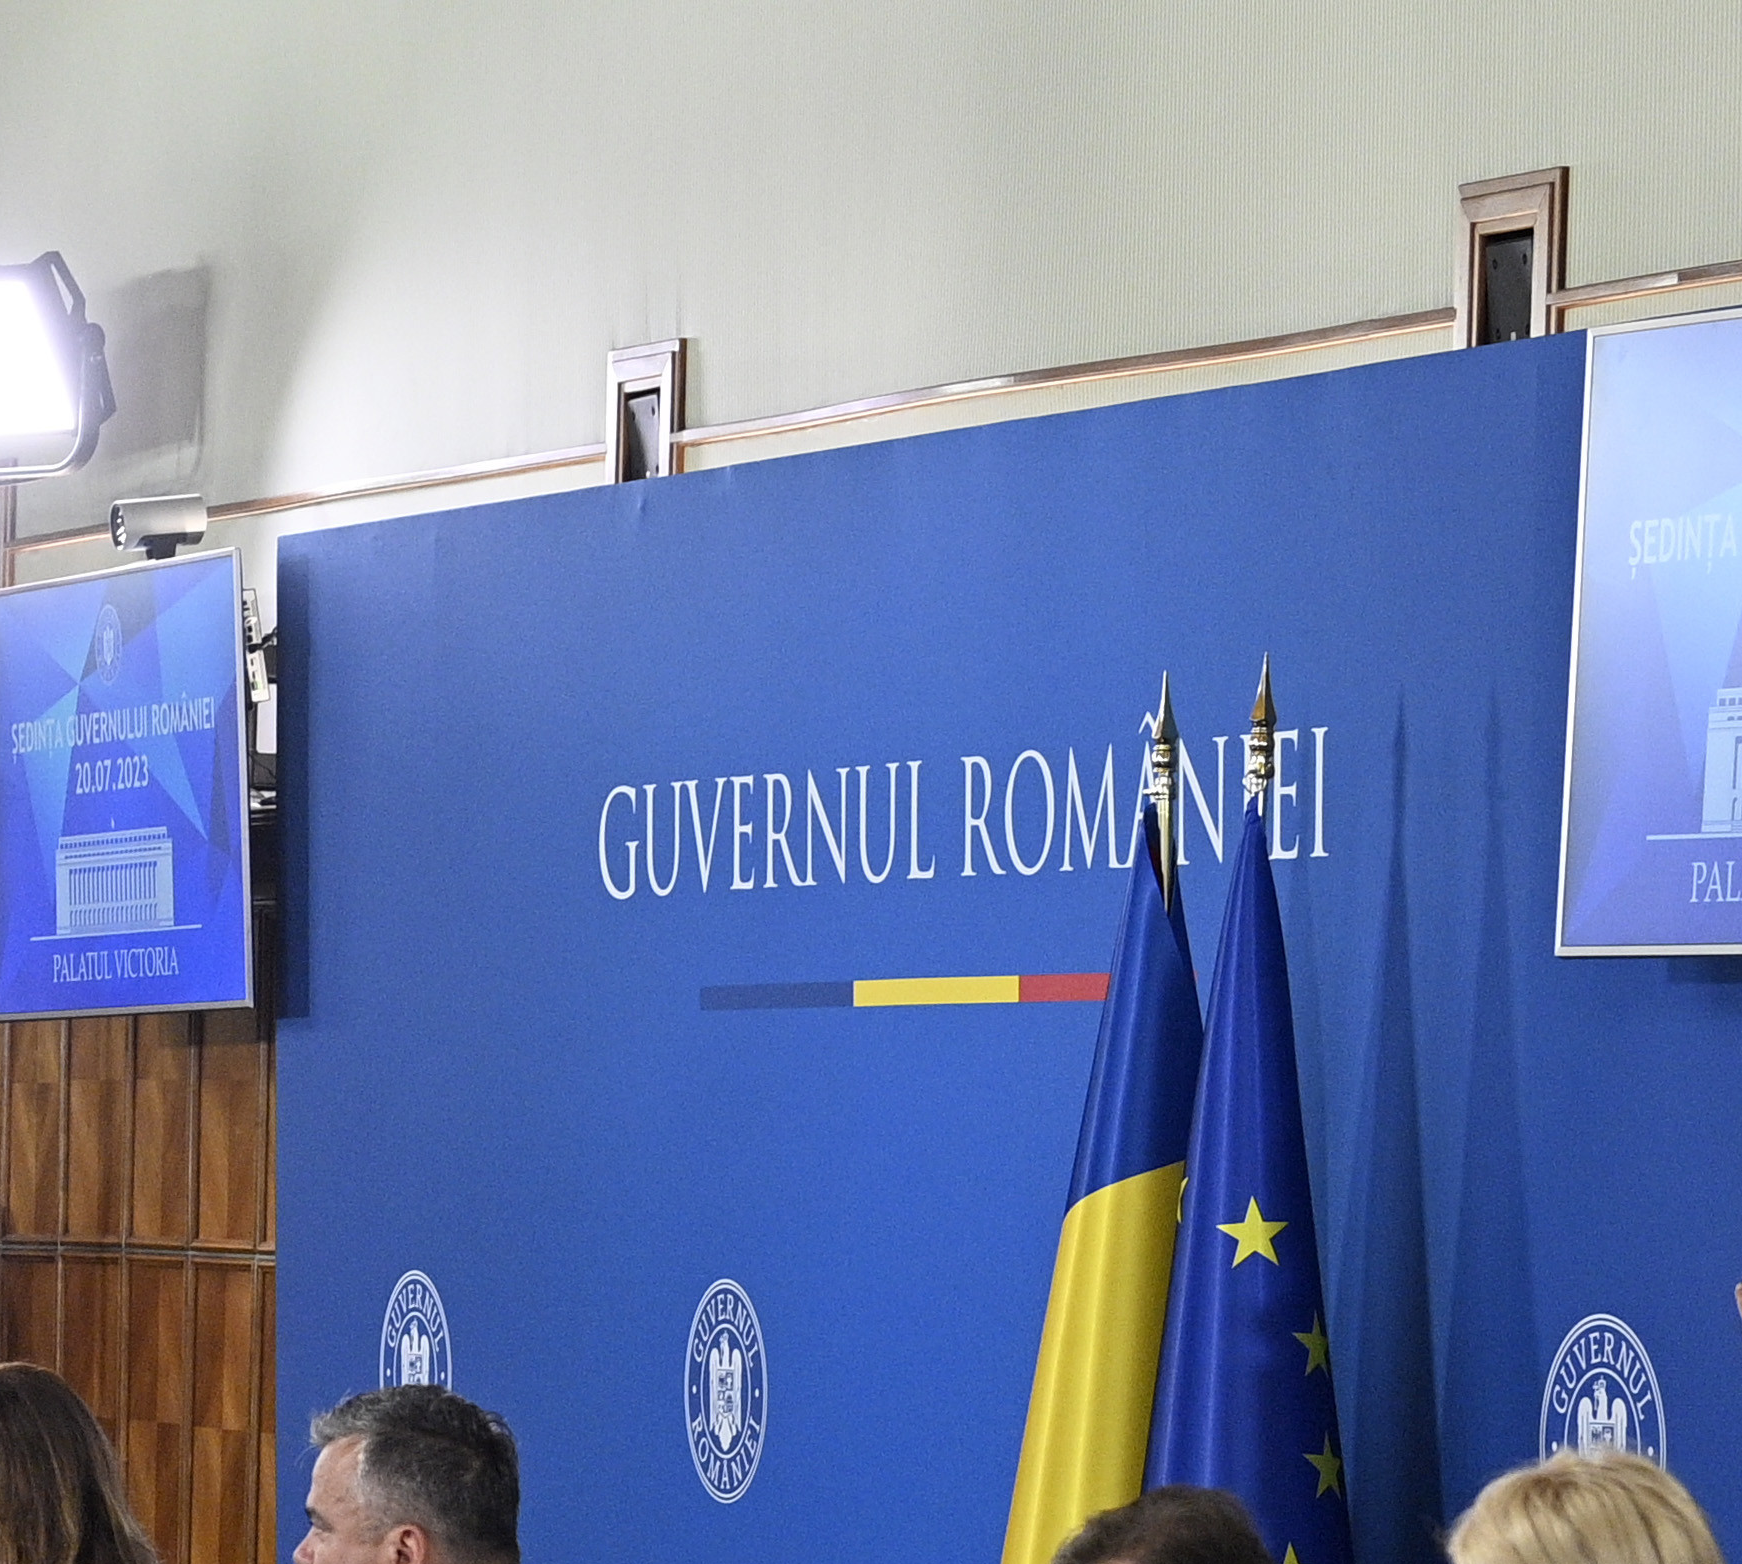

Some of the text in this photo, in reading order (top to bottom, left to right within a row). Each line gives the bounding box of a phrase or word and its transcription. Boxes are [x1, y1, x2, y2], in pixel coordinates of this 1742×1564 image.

[67, 705, 148, 747] GUVERNULUI
[151, 691, 216, 736] ROMÂNIEI
[75, 754, 149, 794] 20.07.2023
[598, 759, 936, 900] GUVERNUL
[52, 946, 180, 983] PALATUL VICTORIA
[387, 1284, 444, 1352] GUVERNUL
[693, 1293, 759, 1368] GUVERNUL
[1552, 1331, 1652, 1421] GUVERNUL
